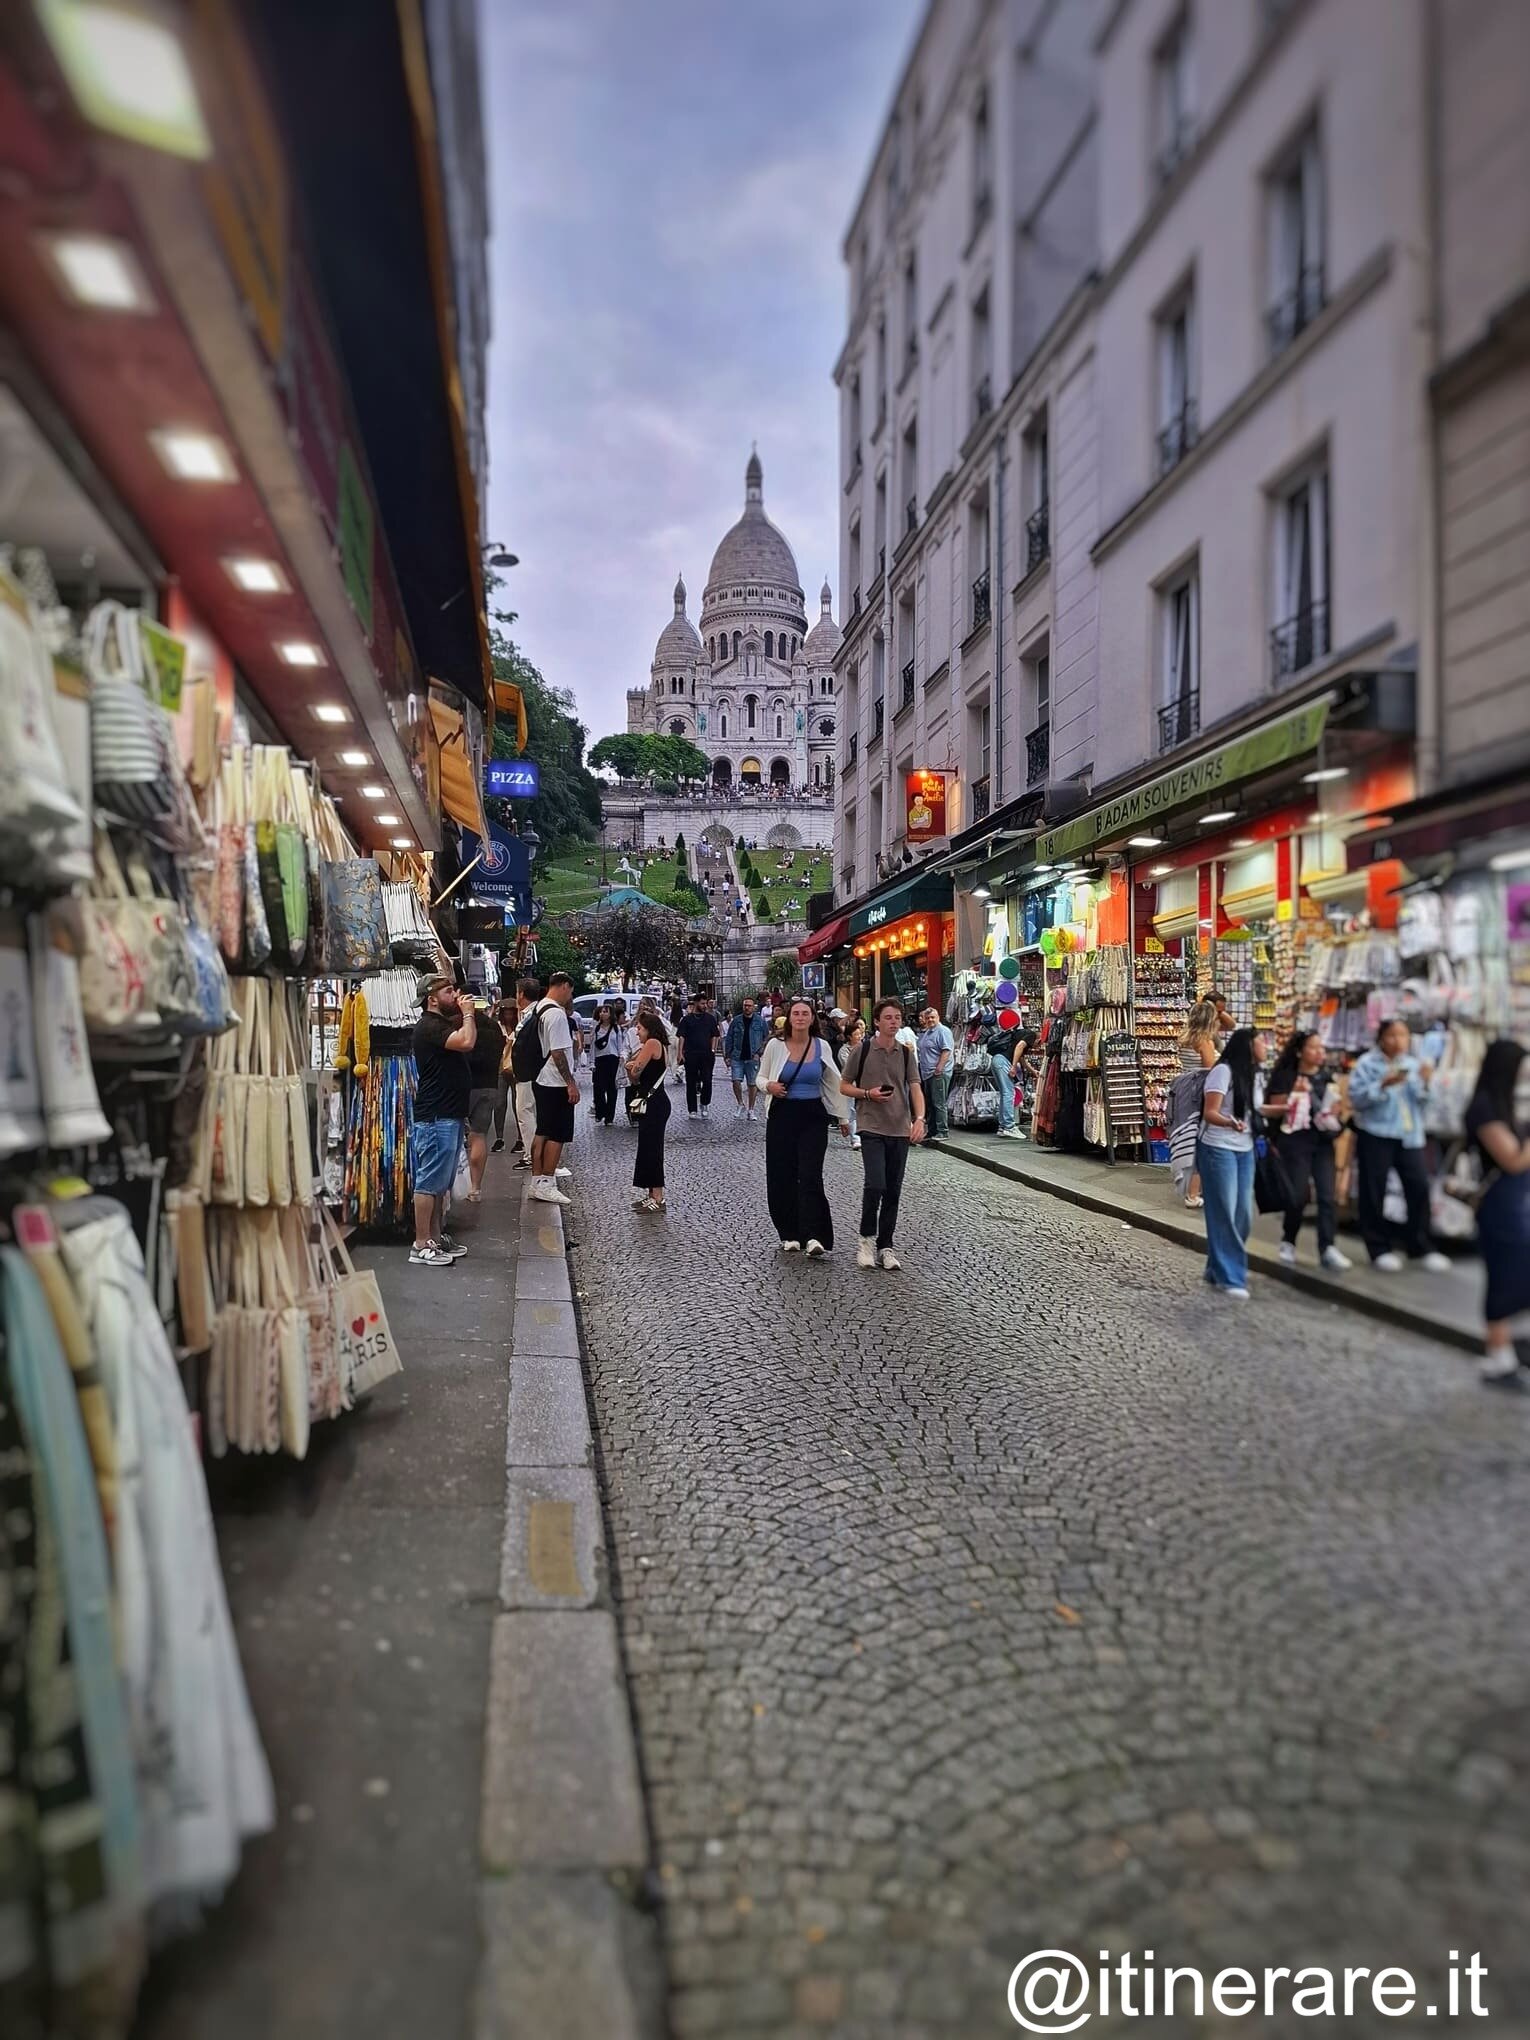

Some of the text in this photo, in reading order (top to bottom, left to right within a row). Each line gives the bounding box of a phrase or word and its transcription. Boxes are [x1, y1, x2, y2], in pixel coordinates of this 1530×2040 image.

[491, 771, 535, 785] PIZZA
[1144, 758, 1223, 810] SOUVENIRS
[1045, 838, 1054, 857] 18
[471, 881, 513, 892] Welcome
[1107, 1042, 1135, 1052] MUSIC
